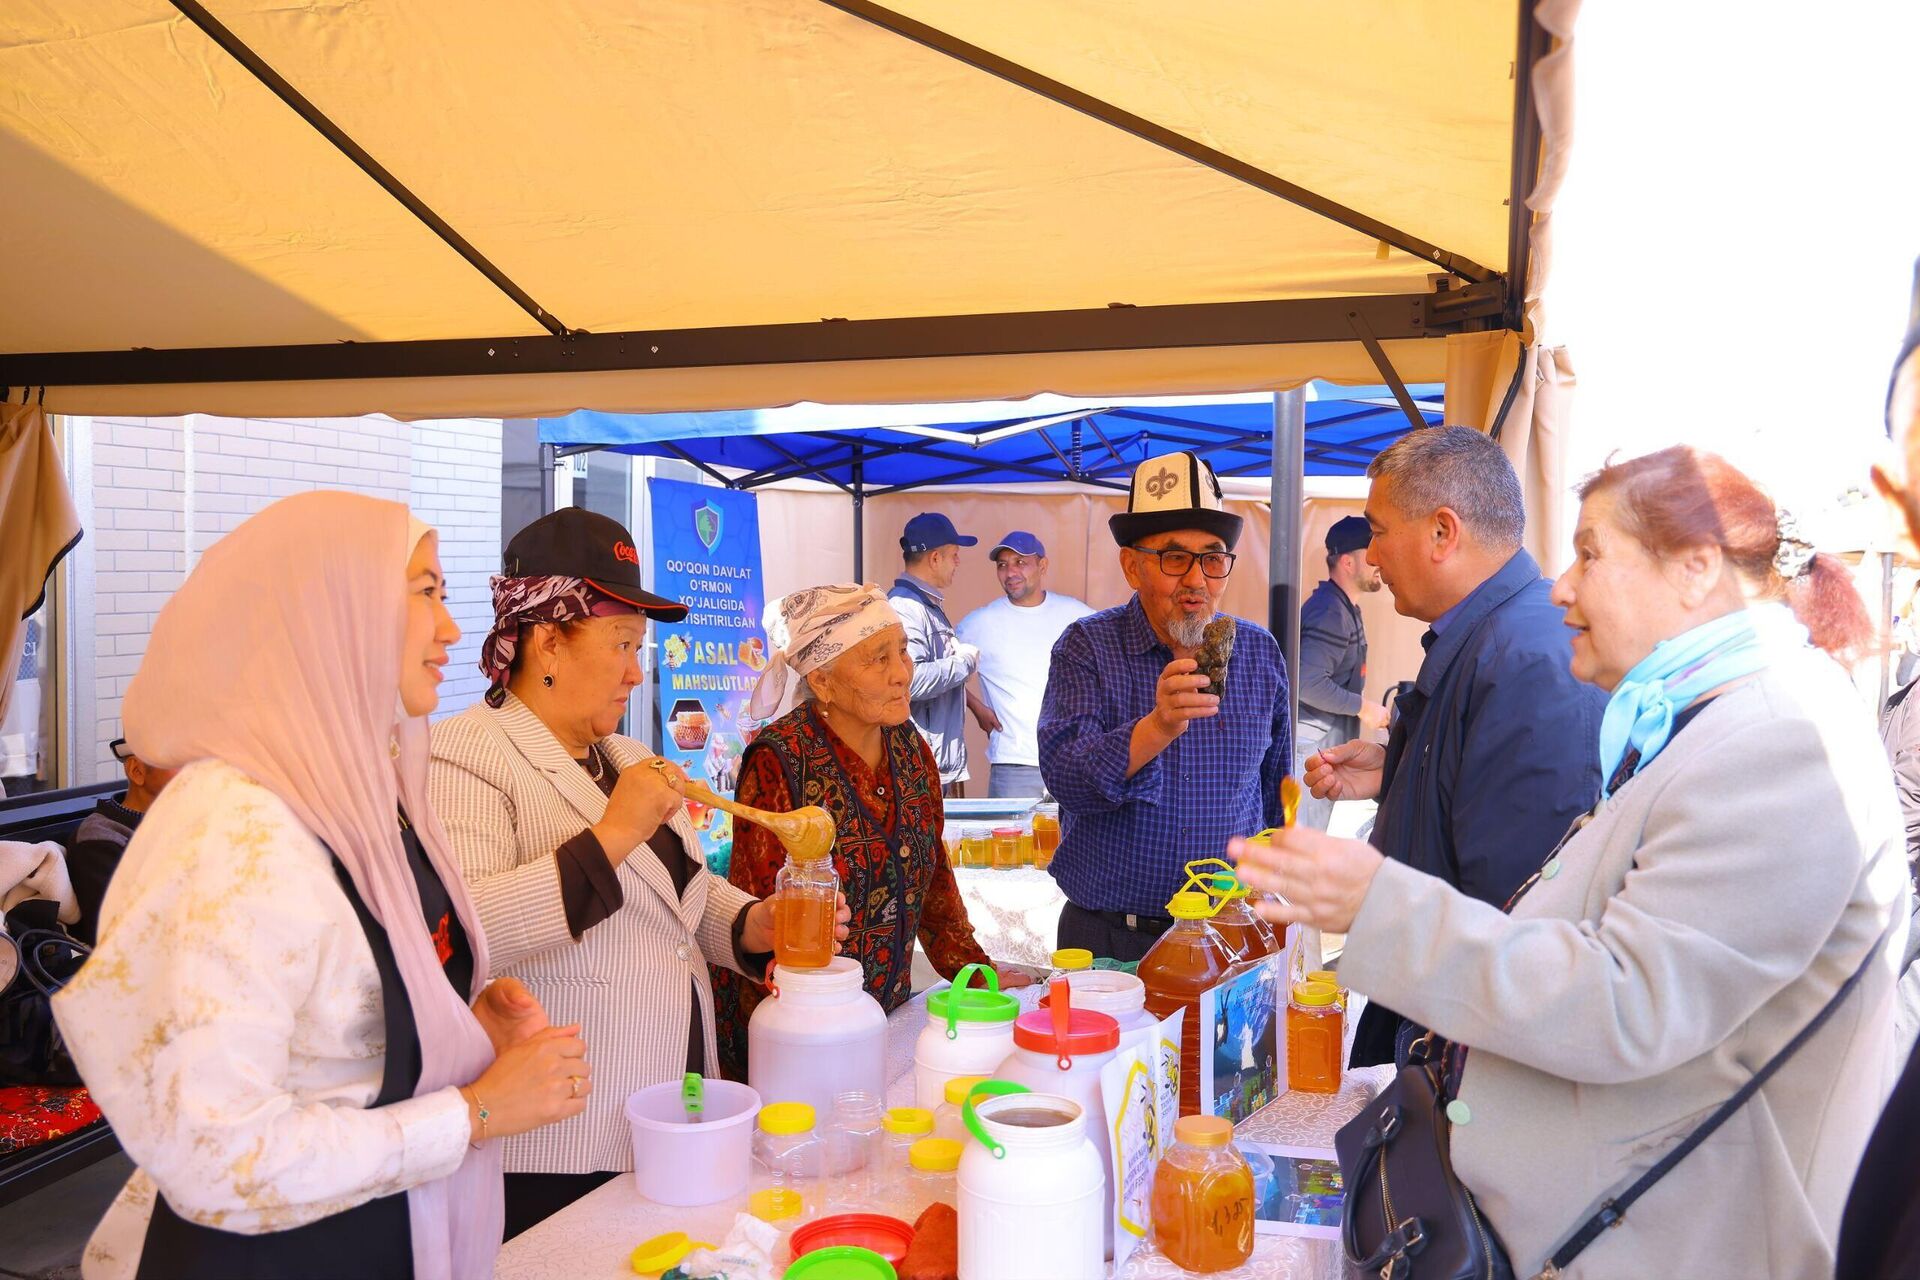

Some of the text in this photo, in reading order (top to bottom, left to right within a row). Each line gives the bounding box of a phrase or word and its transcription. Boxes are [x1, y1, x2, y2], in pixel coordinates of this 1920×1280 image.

[712, 565, 752, 579] DAVLAT
[677, 613, 756, 628] TISHTIRILGAN
[694, 640, 738, 666] ASAL
[672, 673, 760, 692] MAHSULOTLAR
